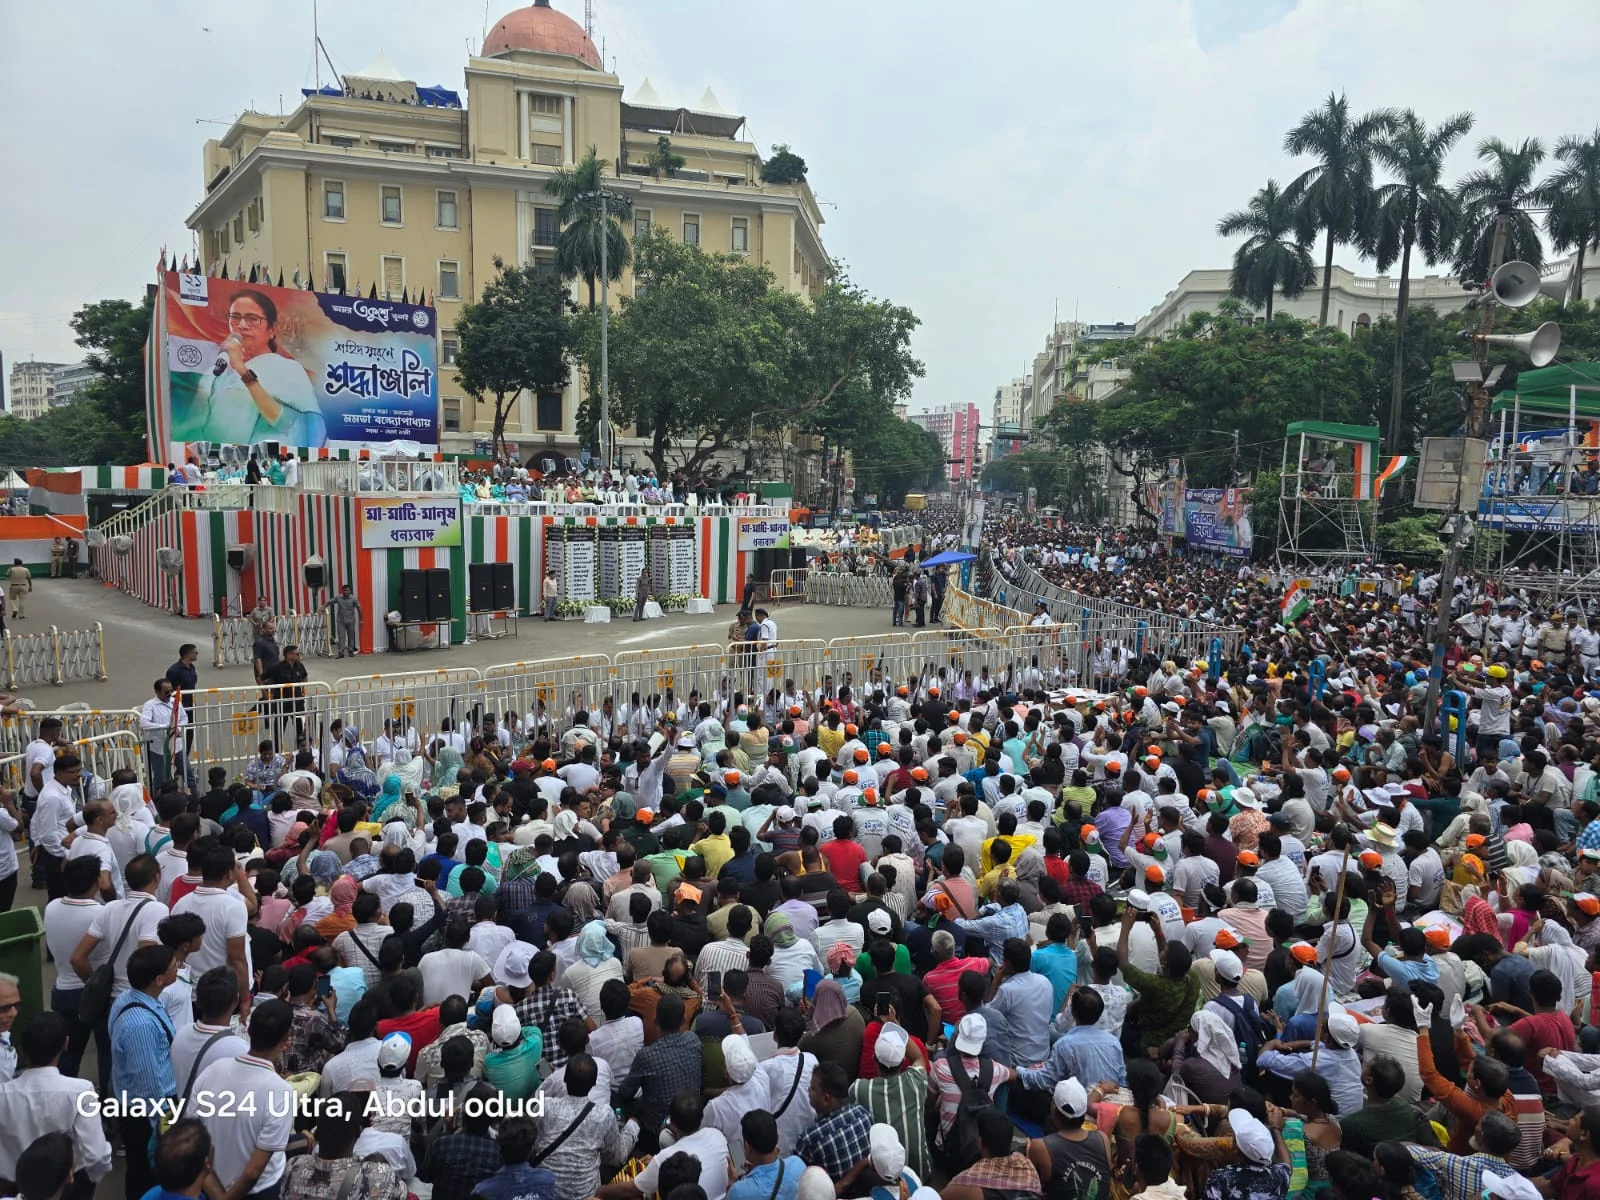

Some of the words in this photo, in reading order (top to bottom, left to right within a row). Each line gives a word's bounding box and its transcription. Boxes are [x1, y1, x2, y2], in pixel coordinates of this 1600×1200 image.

[185, 274, 202, 287] ২১
[325, 349, 433, 398] শ্রদ্ধাঞ্জলি
[342, 414, 371, 424] মমতা
[373, 415, 431, 428] বন্দ্যোপাধ্যায়
[365, 503, 456, 526] মা-মাটি-মানুষ
[389, 529, 435, 542] ধন্যবাদ
[741, 521, 788, 536] মা-মাটি-মানুষ
